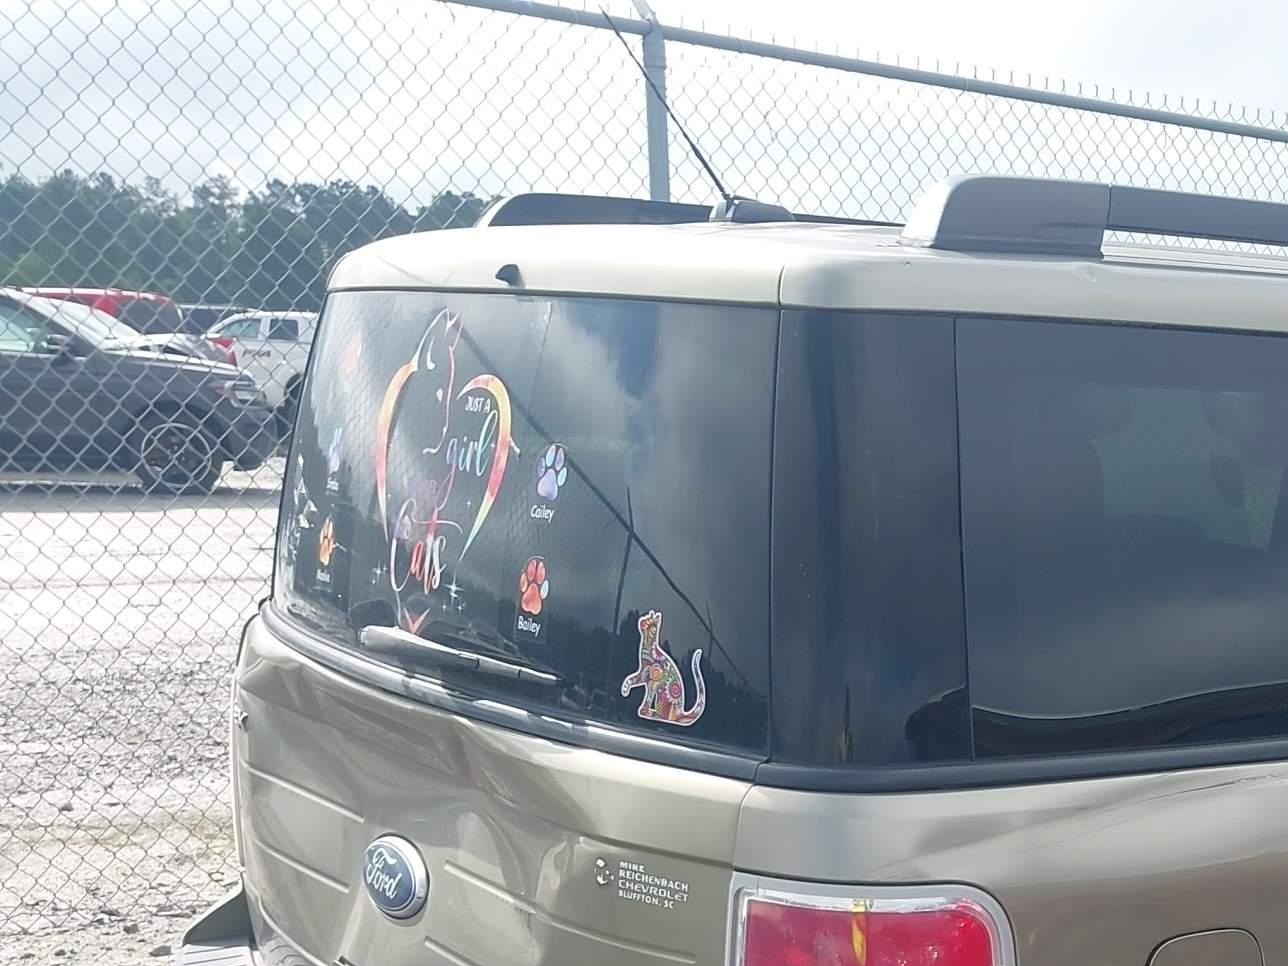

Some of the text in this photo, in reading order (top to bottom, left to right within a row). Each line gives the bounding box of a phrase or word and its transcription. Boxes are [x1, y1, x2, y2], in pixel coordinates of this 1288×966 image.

[465, 395, 491, 413] JUST A
[446, 410, 498, 476] girl
[391, 498, 450, 595] Cats
[517, 615, 541, 637] Bailey
[365, 847, 403, 899] Ford
[619, 869, 689, 892] REICHENBACH
[618, 879, 689, 902] CHEVROLET
[663, 899, 674, 909] SC
